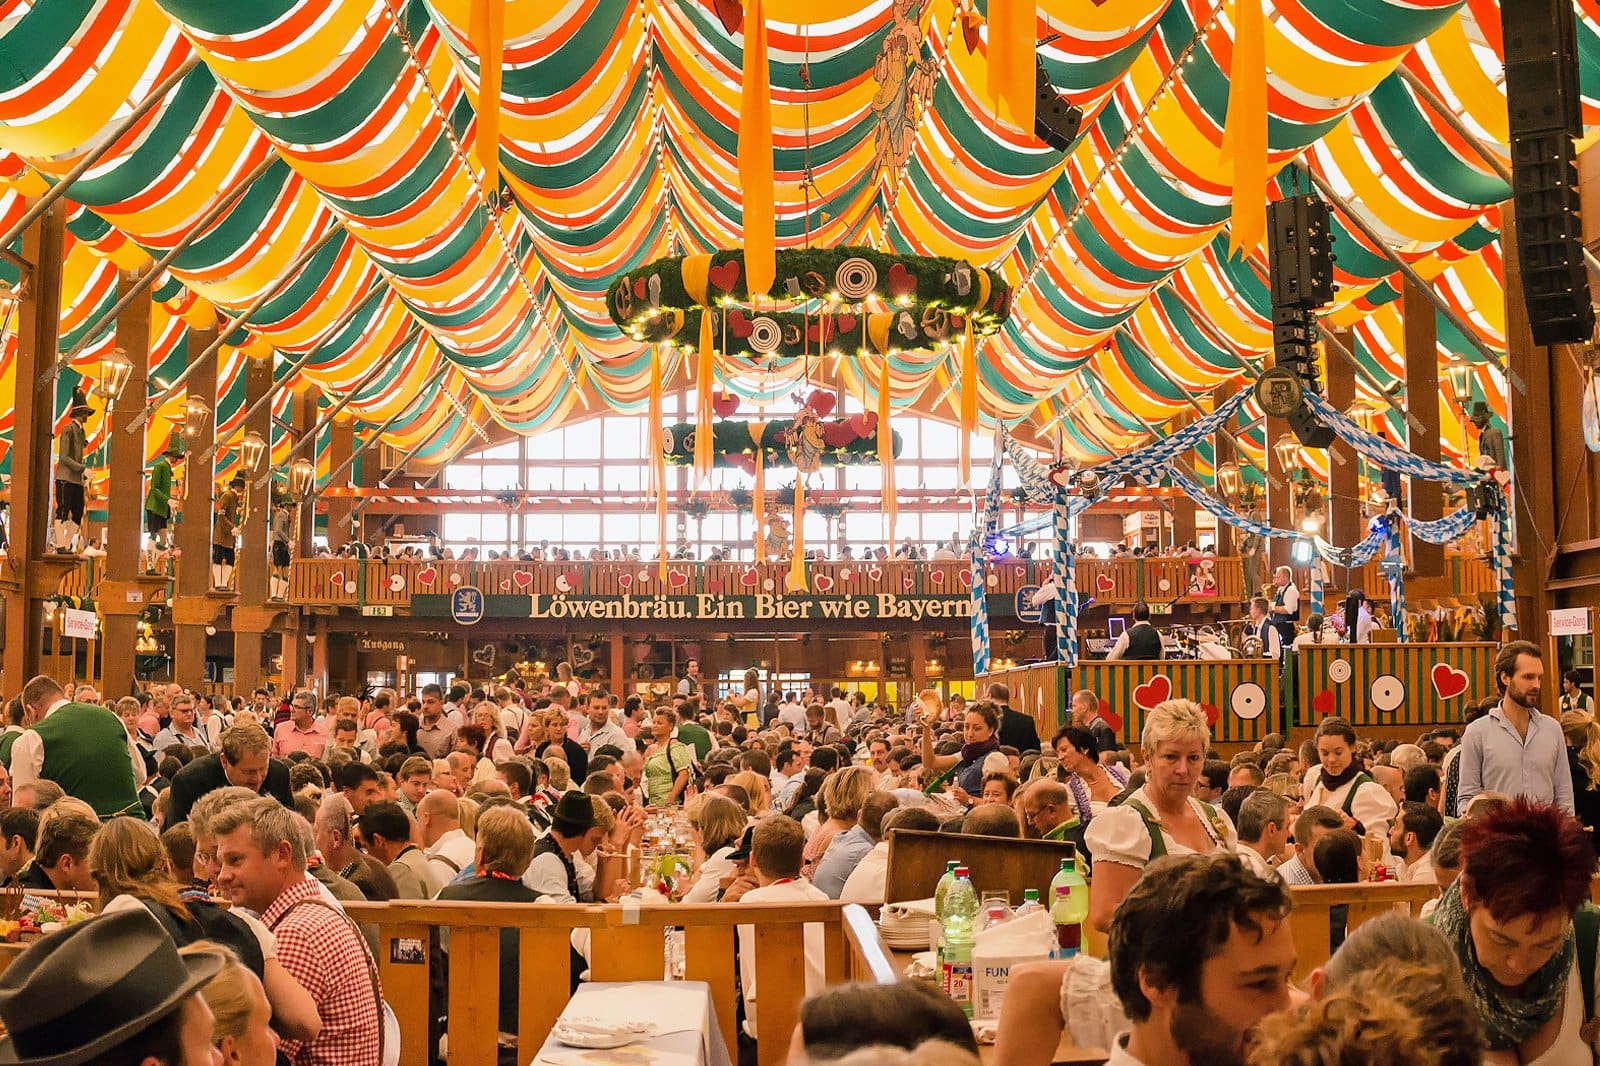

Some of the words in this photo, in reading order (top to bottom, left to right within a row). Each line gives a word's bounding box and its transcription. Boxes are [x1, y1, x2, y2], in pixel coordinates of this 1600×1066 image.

[696, 593, 745, 619] Ein
[754, 593, 813, 619] Bier
[820, 594, 870, 618] wie
[876, 593, 972, 621] Bayern
[1553, 616, 1585, 629] Service-Gang
[362, 640, 405, 651] Ausgang
